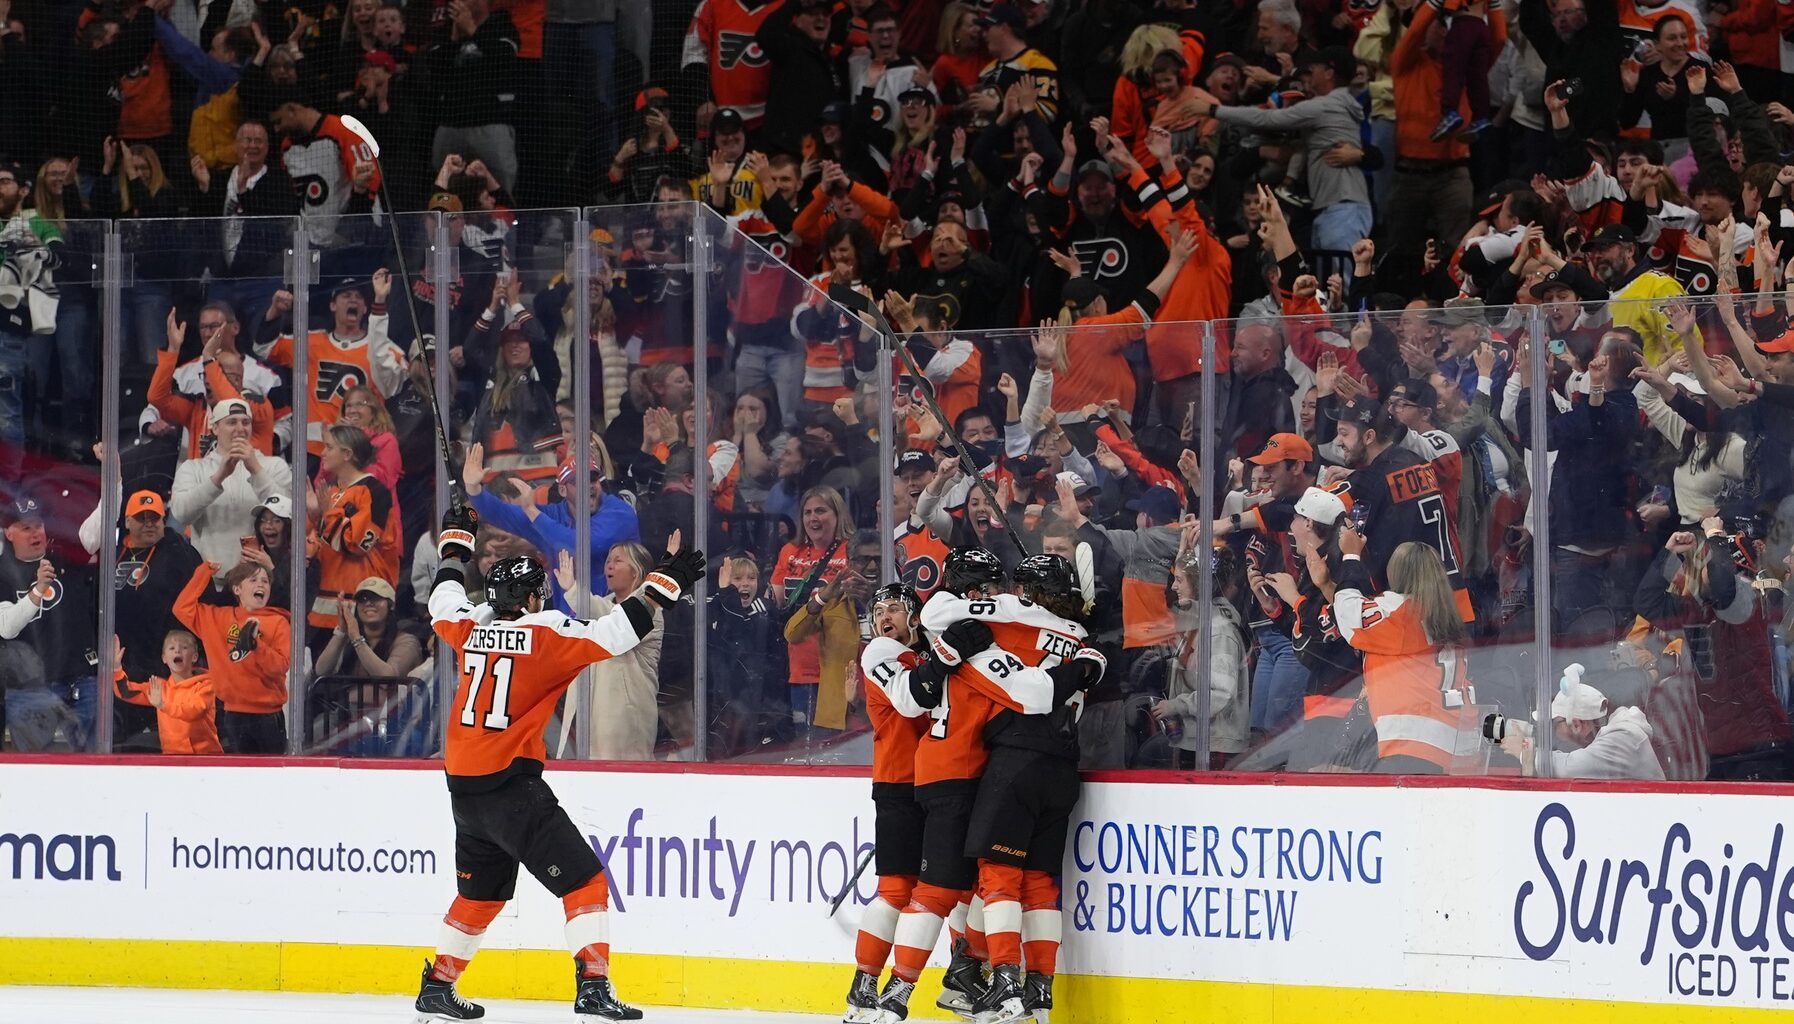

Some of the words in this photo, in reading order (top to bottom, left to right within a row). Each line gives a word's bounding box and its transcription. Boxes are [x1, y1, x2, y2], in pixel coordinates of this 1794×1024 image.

[488, 588, 497, 600] 71
[460, 649, 515, 731] 71
[872, 661, 896, 687] 11
[988, 654, 1024, 679] 94
[172, 836, 437, 875] holmanauto.com
[588, 807, 757, 917] xfinity
[1073, 820, 1223, 877] CONNER
[1230, 826, 1383, 884] STRONG
[1073, 879, 1096, 932] &
[1107, 882, 1298, 942] BUCKELEW
[1669, 952, 1737, 997] ICED
[1749, 956, 1794, 1000] TE
